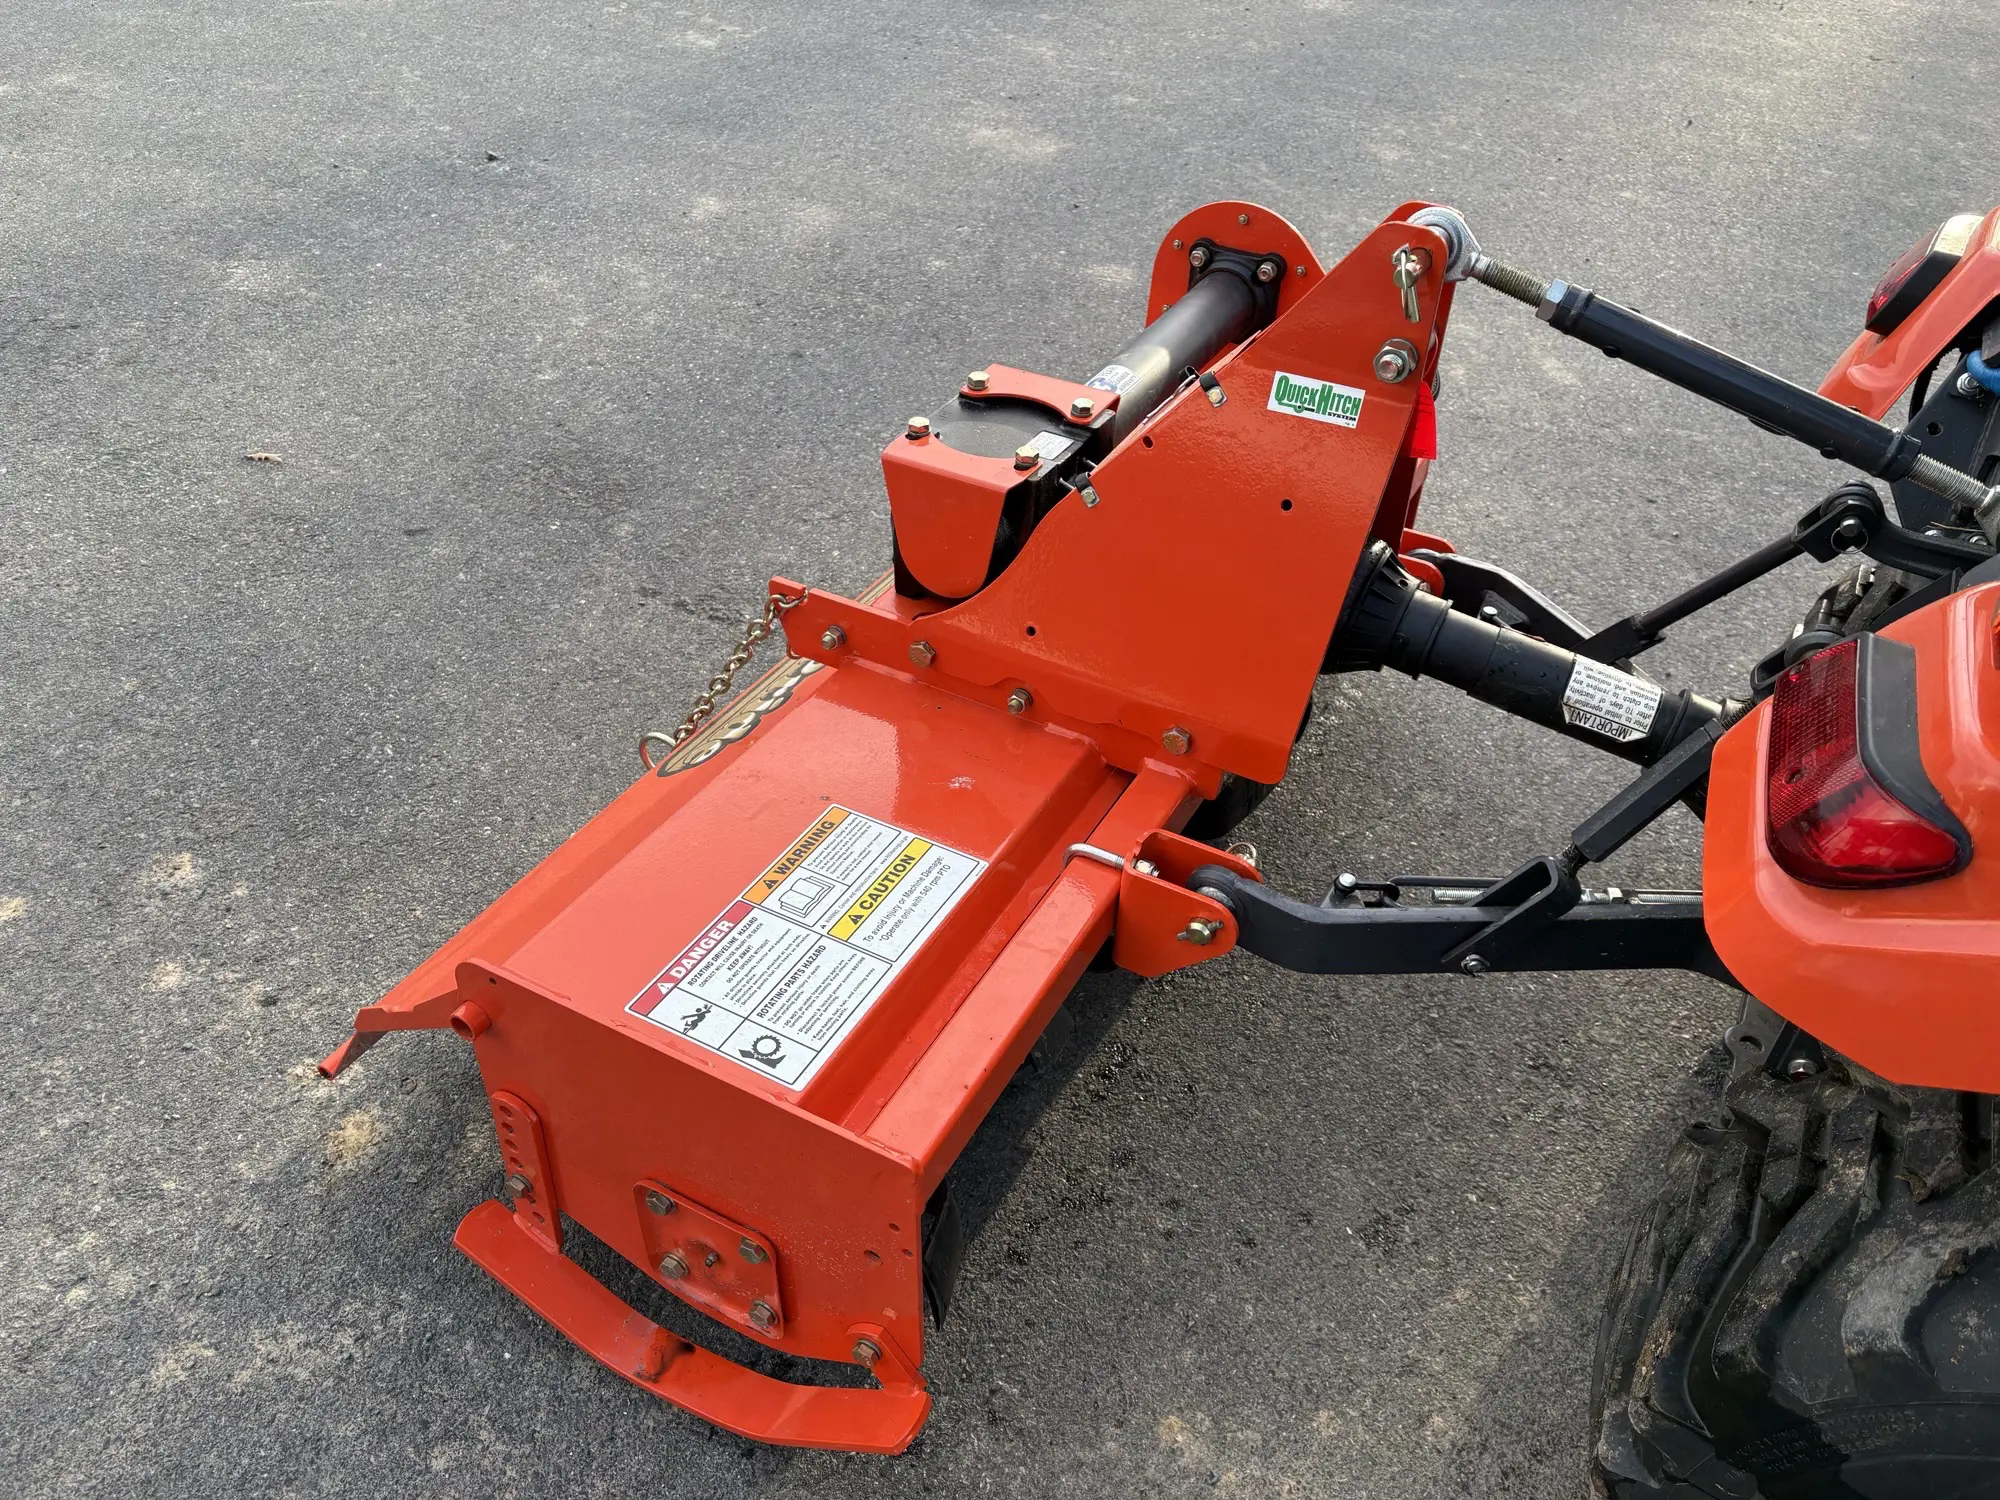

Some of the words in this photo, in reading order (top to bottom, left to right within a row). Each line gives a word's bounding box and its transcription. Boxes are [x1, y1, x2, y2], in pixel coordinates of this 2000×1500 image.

[1327, 411, 1356, 422] SYSTEM
[1572, 676, 1583, 685] any
[1585, 673, 1611, 686] moisture
[1585, 682, 1609, 695] remove
[1622, 695, 1641, 706] clutch
[1629, 689, 1657, 702] oxidation
[1574, 697, 1603, 713] operation
[1609, 699, 1623, 710] days
[1625, 706, 1633, 714] 10
[1643, 702, 1655, 711] slip
[1604, 709, 1622, 720] initial
[1636, 710, 1651, 720] after
[1632, 719, 1647, 729] Prior
[772, 820, 835, 875] WARNING
[857, 854, 916, 910] CAUTION
[899, 907, 915, 919] only
[910, 895, 924, 907] with
[919, 885, 932, 895] 540
[929, 876, 942, 886] rpm
[937, 864, 951, 876] PTO
[862, 934, 874, 942] To
[869, 919, 887, 935] avoid
[883, 904, 903, 920] Injury
[902, 876, 925, 897] Machine
[920, 855, 946, 877] Damage:
[668, 919, 734, 978] DANGER
[686, 961, 714, 985] ROTATING
[710, 936, 739, 961] DRIVELINE
[736, 916, 759, 936] HAZARD
[726, 958, 740, 970] KEEP
[737, 945, 754, 959] AWAY!
[756, 987, 788, 1018] ROTATING
[783, 968, 805, 987] PARTS
[801, 944, 827, 968] HAZARD
